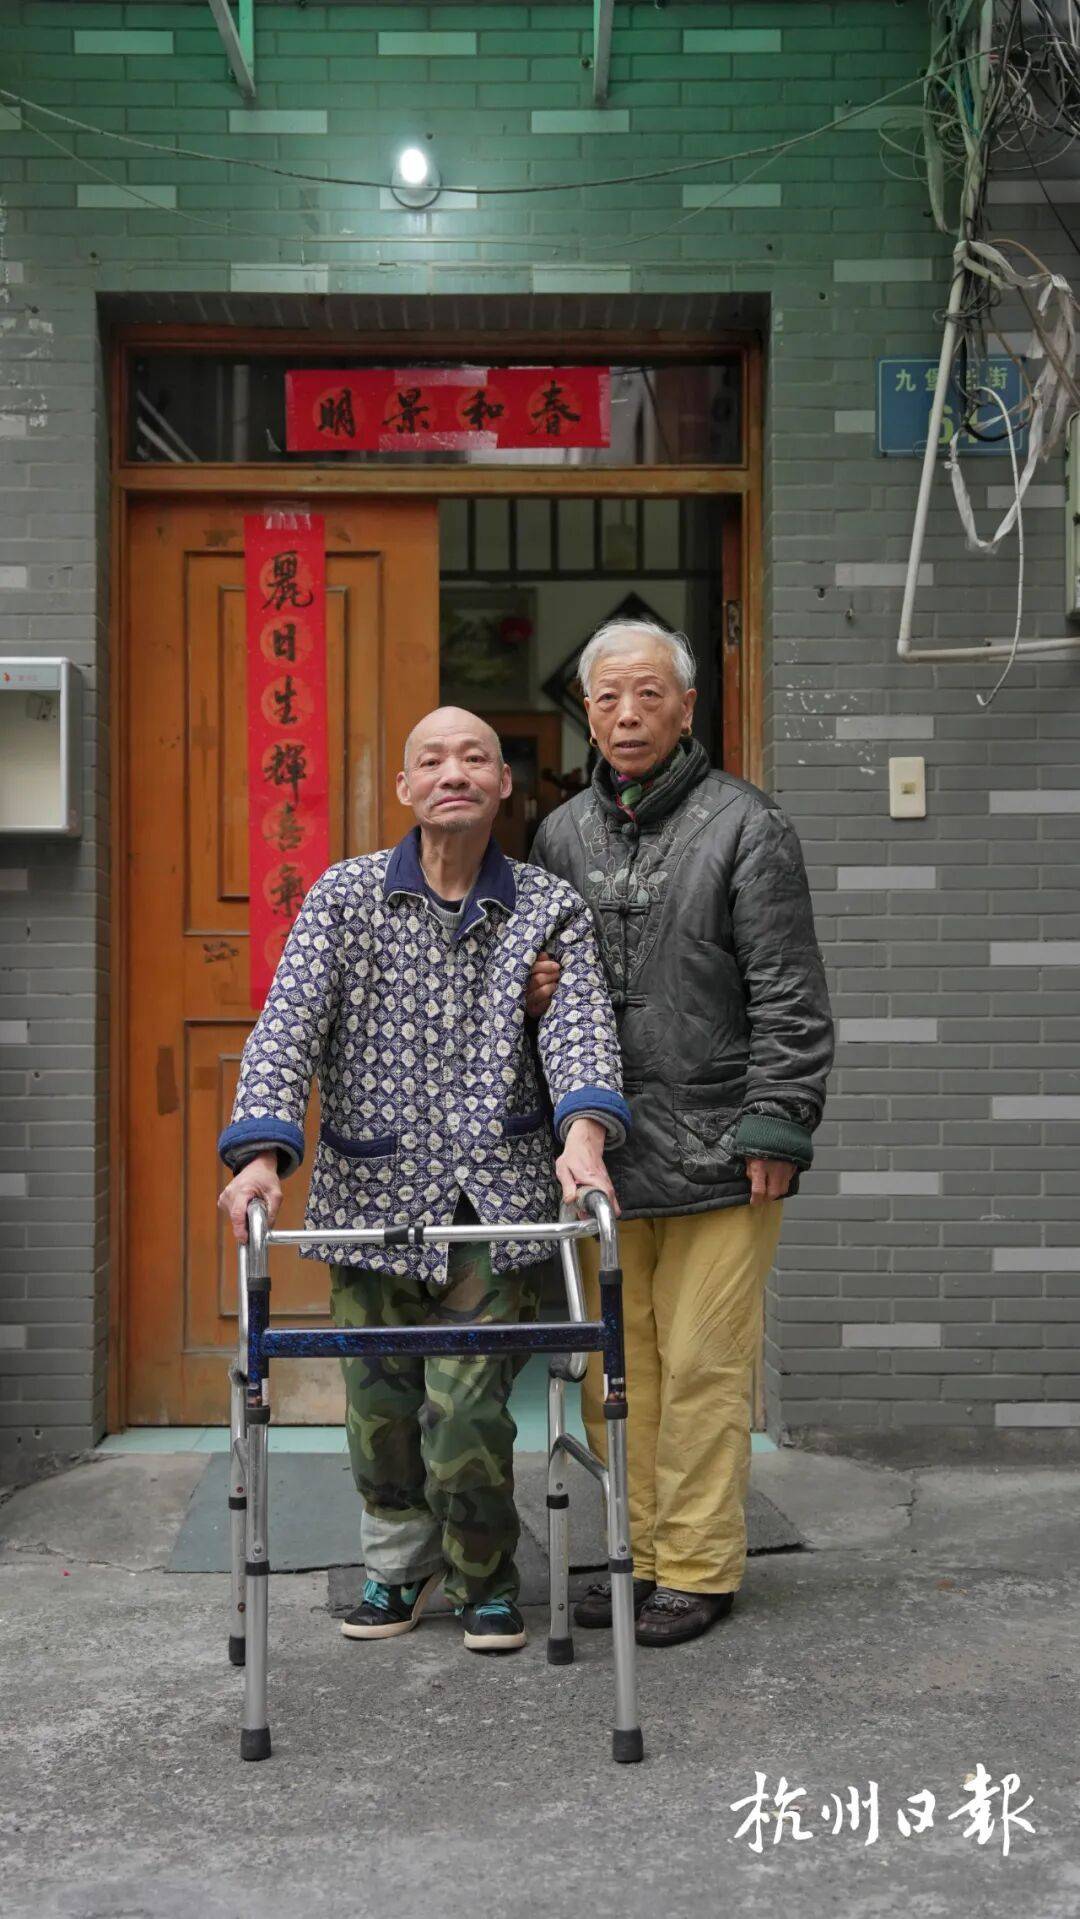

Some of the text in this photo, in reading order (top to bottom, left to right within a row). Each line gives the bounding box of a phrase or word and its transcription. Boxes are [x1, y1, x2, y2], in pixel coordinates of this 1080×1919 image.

[262, 549, 314, 938] 麗日生輝喜氣
